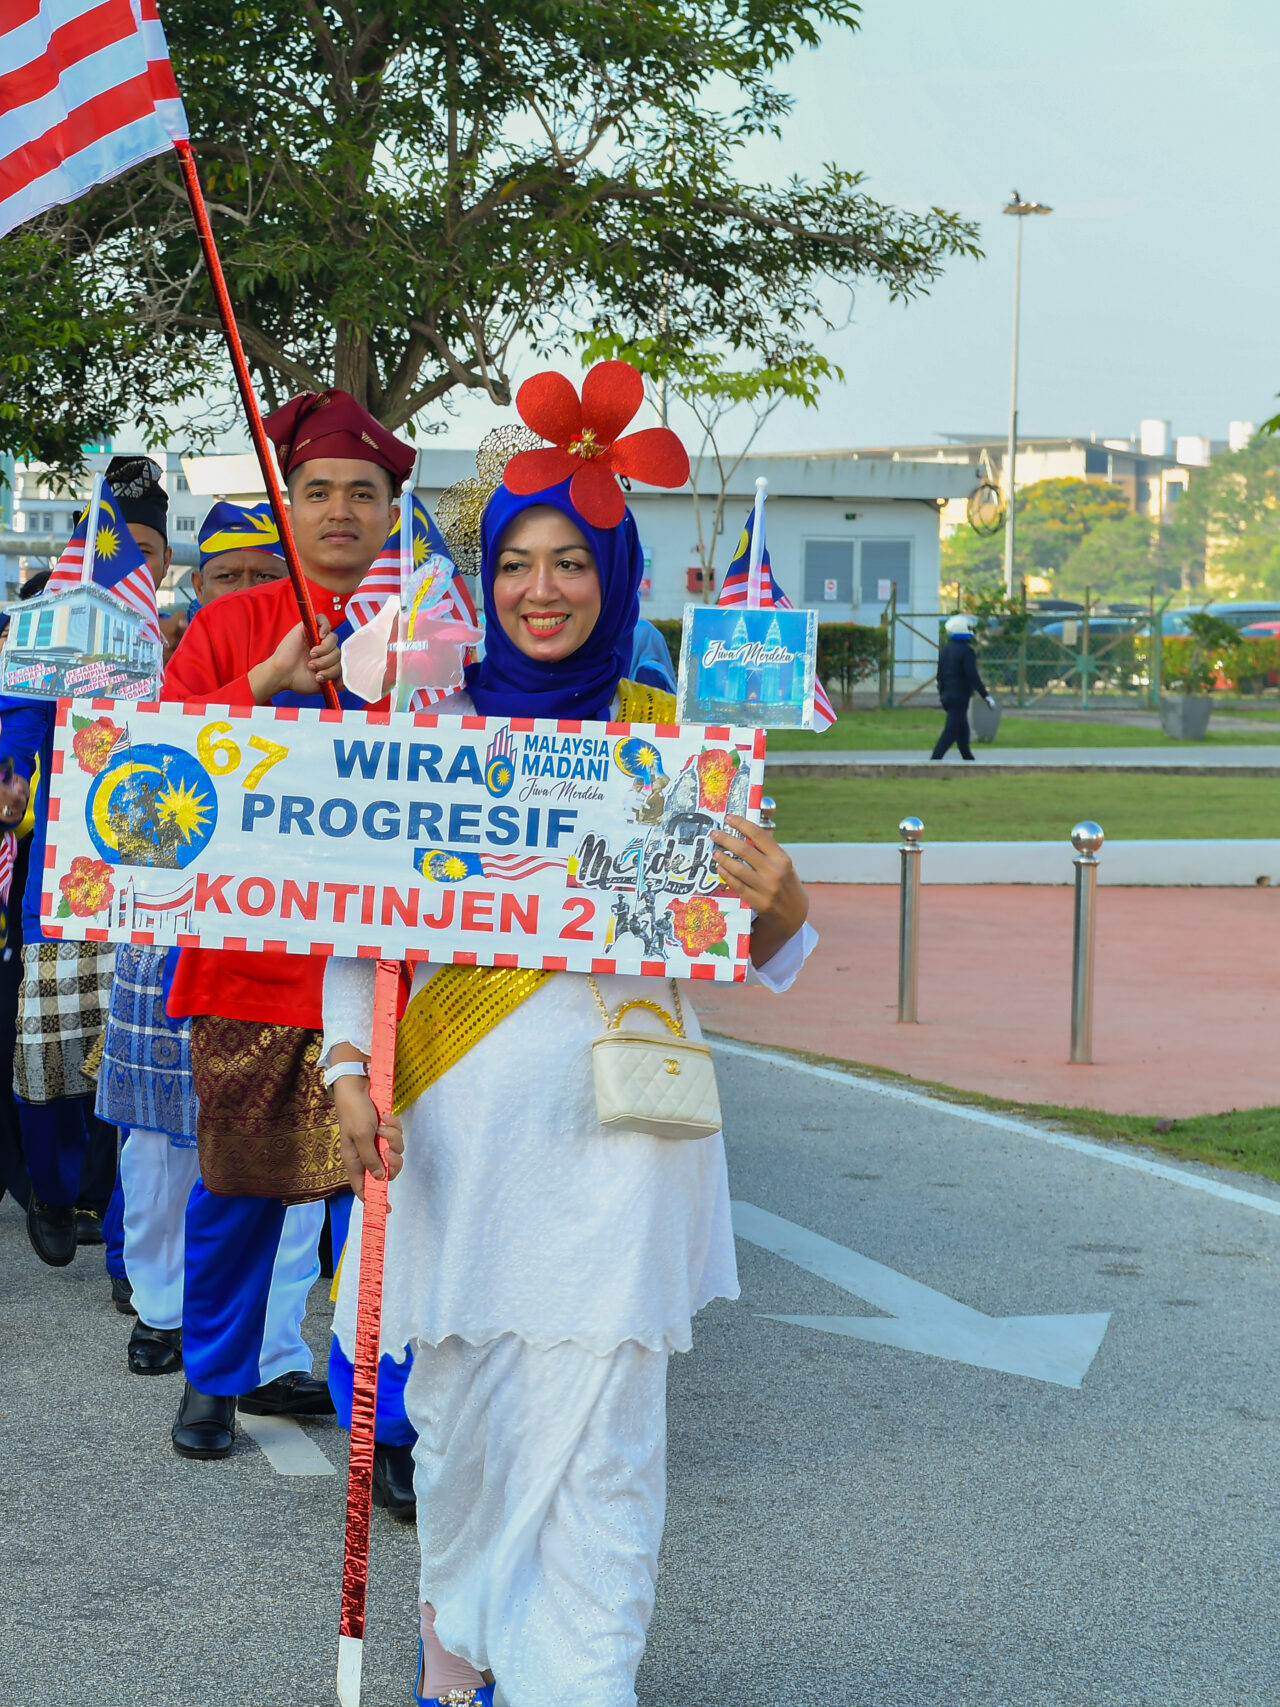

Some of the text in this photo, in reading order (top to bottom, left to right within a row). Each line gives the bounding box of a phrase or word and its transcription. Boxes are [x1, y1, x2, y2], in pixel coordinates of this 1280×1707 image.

[704, 640, 793, 667] Jiwa Merdeka
[65, 665, 116, 686] KEPIMPINAN
[68, 660, 104, 678] PEJABAT
[91, 673, 109, 683] DAN
[74, 673, 128, 695] KOMPETENSI
[117, 677, 154, 695] PEJABAT
[196, 721, 290, 791] 67
[524, 734, 610, 758] MALAYSIA
[333, 738, 487, 786] WIRA
[521, 753, 610, 782] MADANI
[518, 777, 606, 803] Jiwa Merdeka
[241, 792, 578, 849] PROGRESIF
[193, 872, 596, 941] KONTINJEN 2
